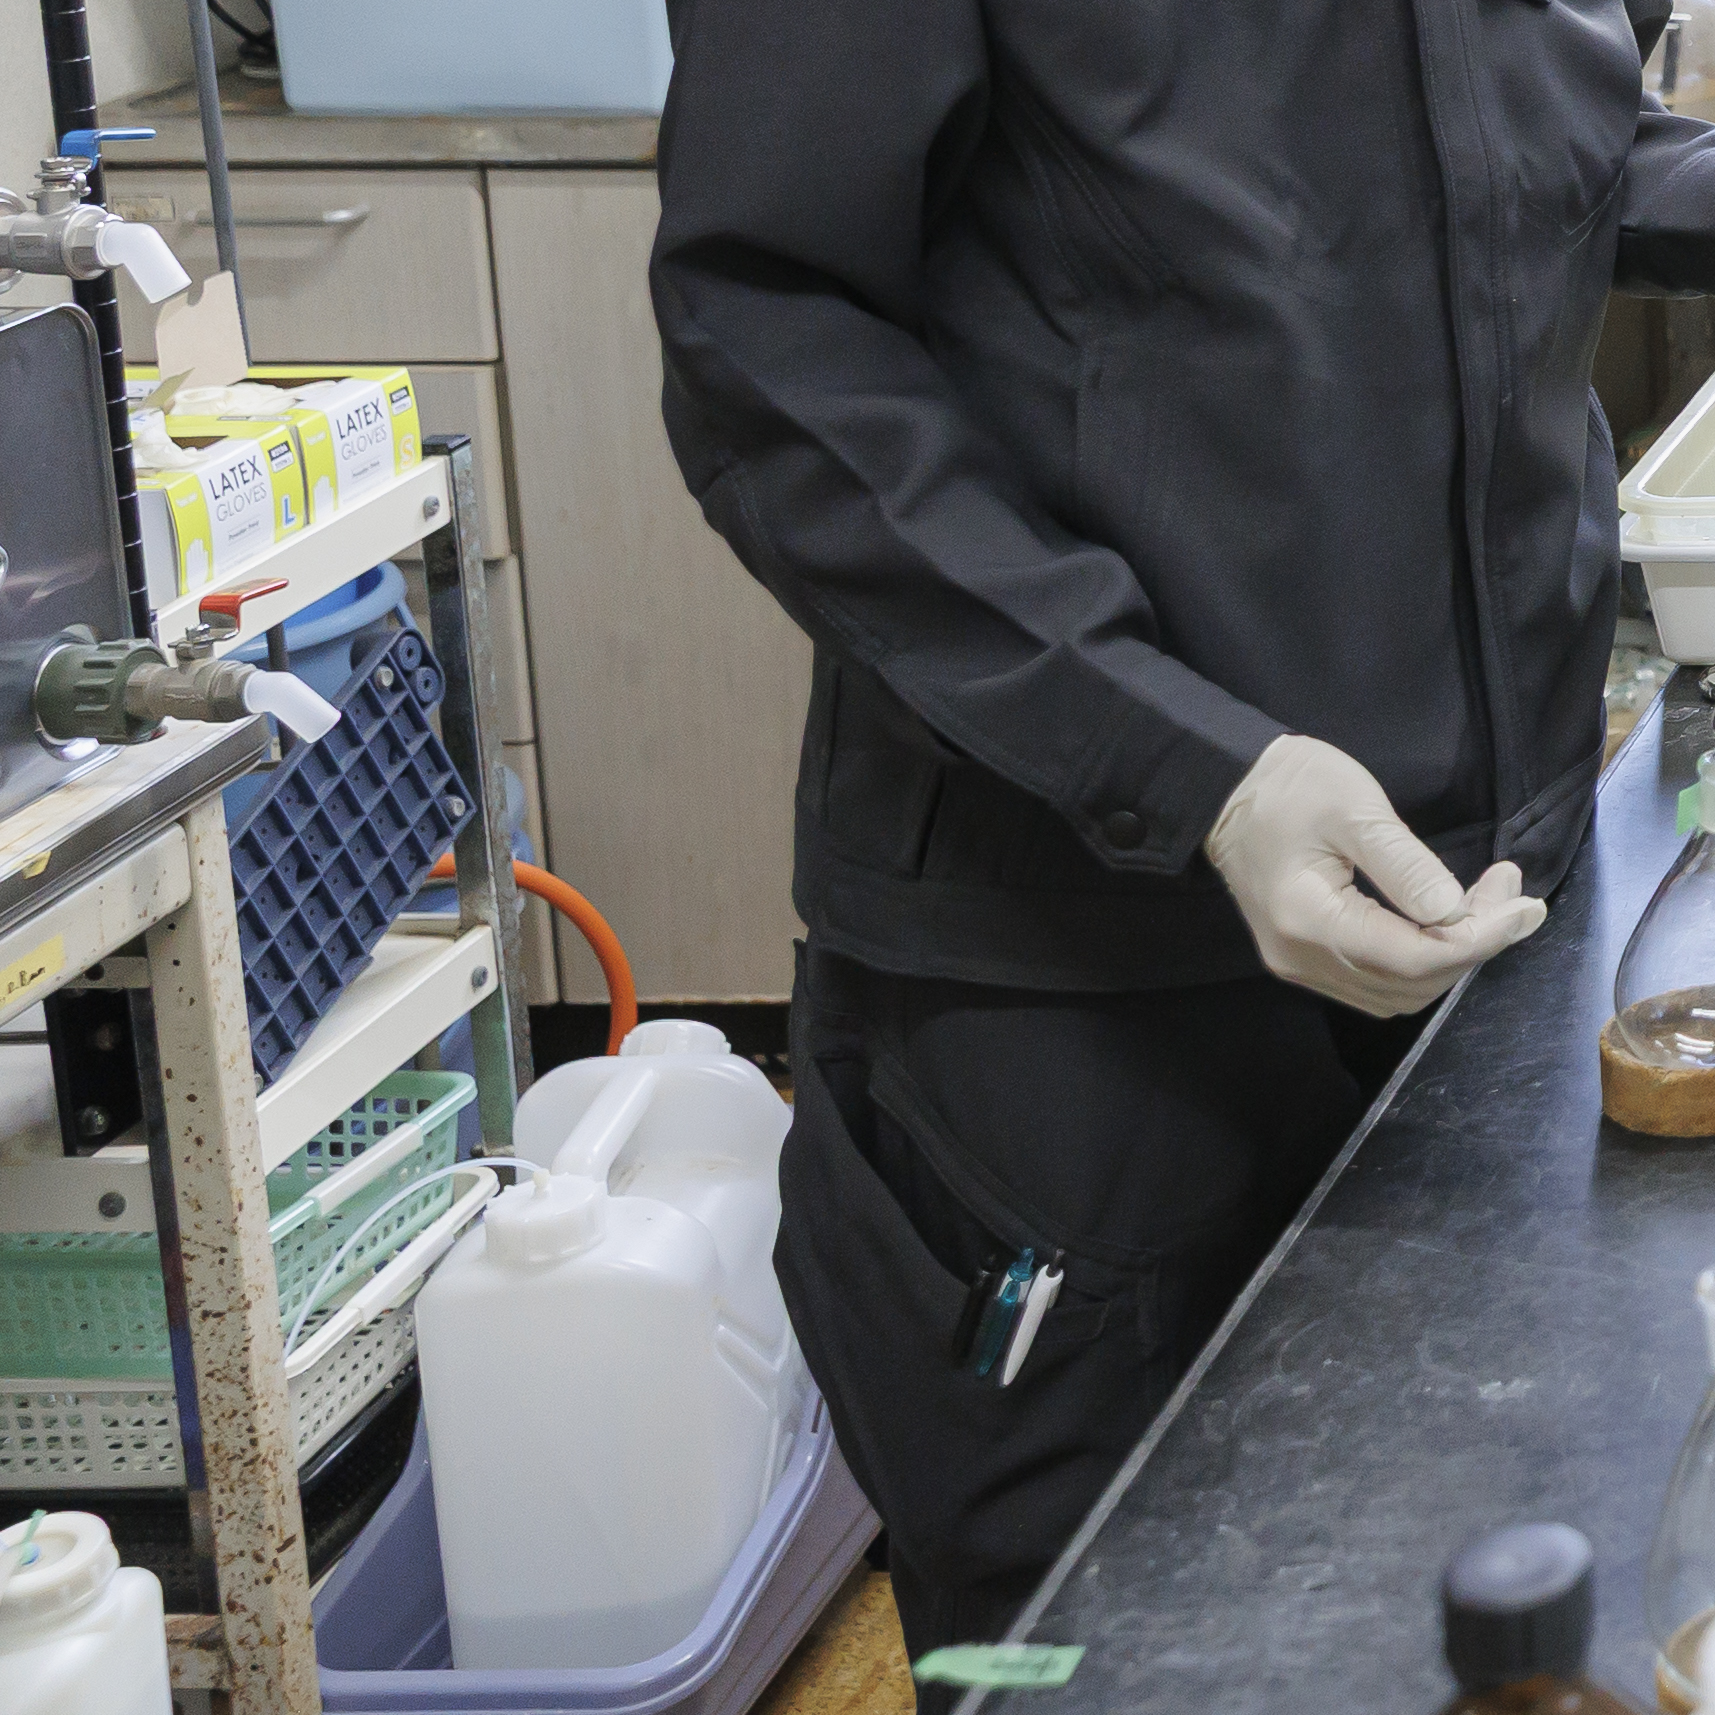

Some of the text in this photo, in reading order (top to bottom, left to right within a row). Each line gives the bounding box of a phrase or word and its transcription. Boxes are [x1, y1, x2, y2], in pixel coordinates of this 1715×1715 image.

[335, 397, 385, 441] LATEX
[341, 425, 388, 461] GLOVES
[208, 454, 264, 501] LATEX
[215, 481, 268, 523] GLOVES
[283, 495, 296, 527] L
